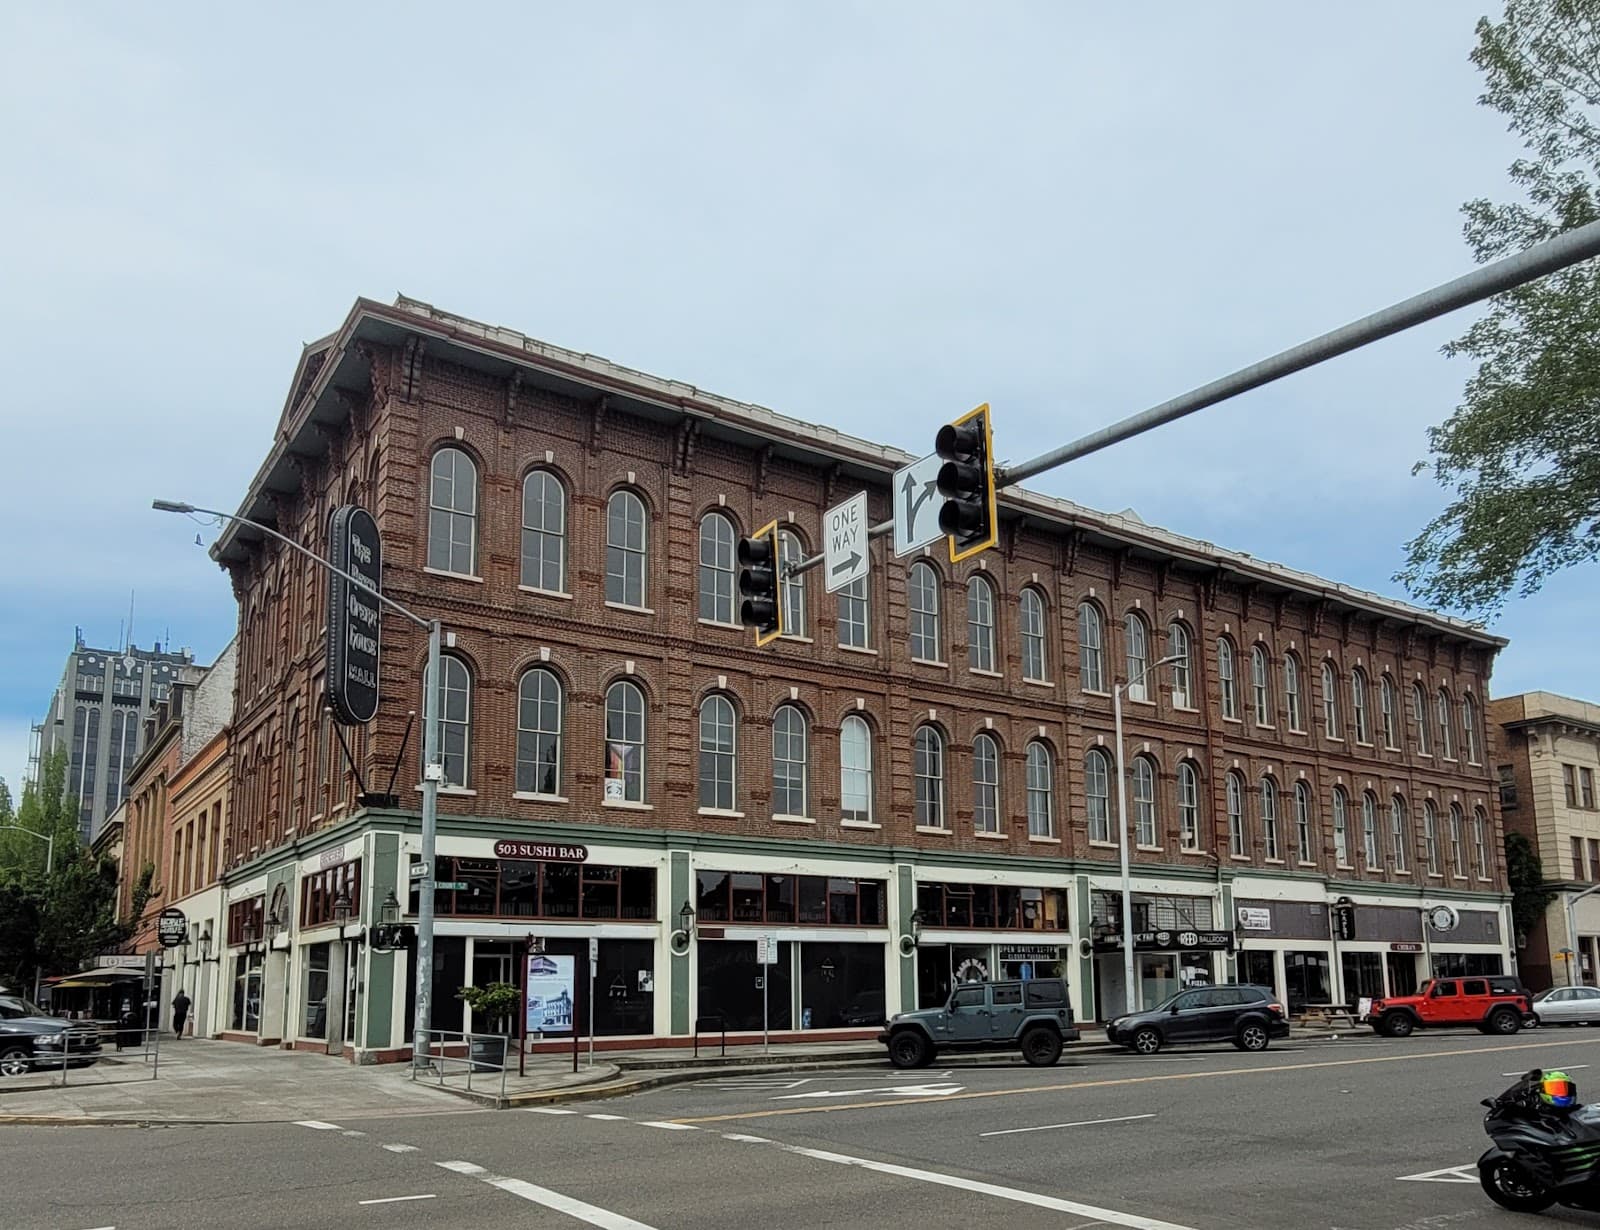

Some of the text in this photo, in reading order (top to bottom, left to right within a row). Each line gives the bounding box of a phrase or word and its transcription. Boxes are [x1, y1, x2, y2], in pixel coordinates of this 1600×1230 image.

[832, 503, 859, 531] ONE
[832, 524, 859, 553] WAY
[497, 844, 585, 859] 503 SUSHI BAR
